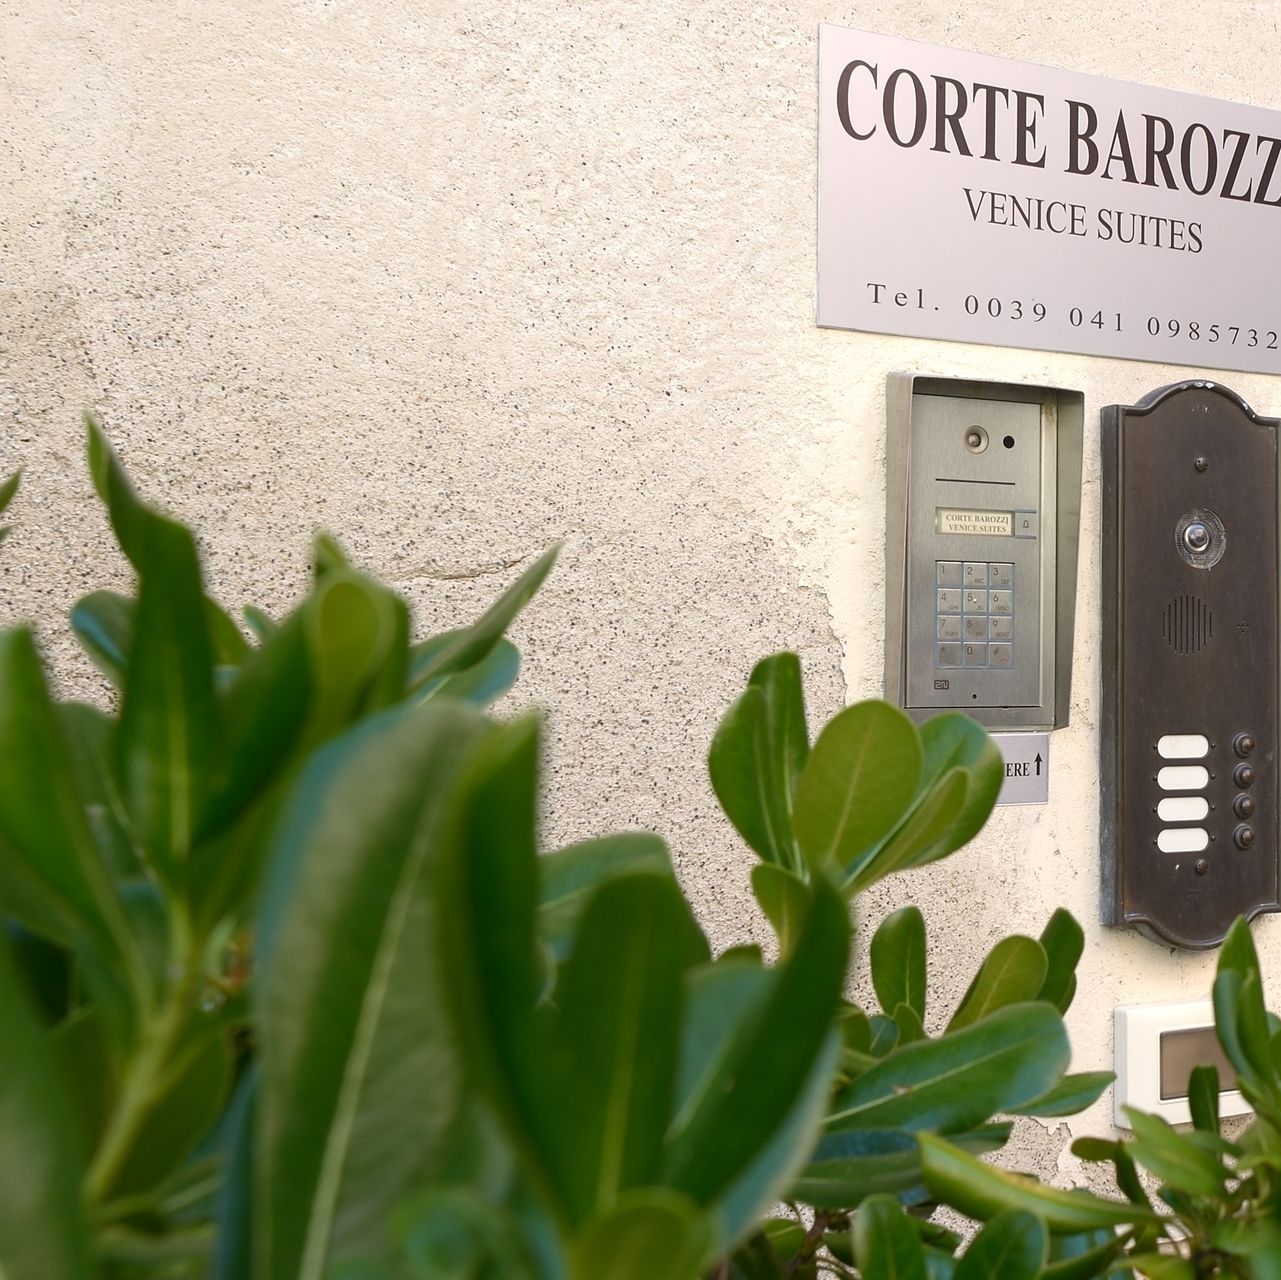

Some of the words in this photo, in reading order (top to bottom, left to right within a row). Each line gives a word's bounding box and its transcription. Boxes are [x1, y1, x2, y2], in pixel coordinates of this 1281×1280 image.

[836, 59, 1047, 169] CORTE
[962, 187, 1088, 237] VENICE
[1097, 208, 1203, 254] SUITES
[867, 283, 939, 311] Tel.
[964, 294, 1047, 322] 0039
[1069, 307, 1124, 332] 041
[1147, 316, 1279, 351] 0985732
[945, 513, 974, 523] CORTE
[974, 515, 1009, 525] BAROZZI
[949, 523, 979, 532] VENICE
[979, 525, 1007, 533] SUITES
[967, 566, 973, 575] 2
[993, 567, 999, 576] 3
[967, 592, 973, 602] 5
[993, 593, 999, 602] 6
[967, 646, 973, 655] 0
[1003, 762, 1031, 777] ERE
